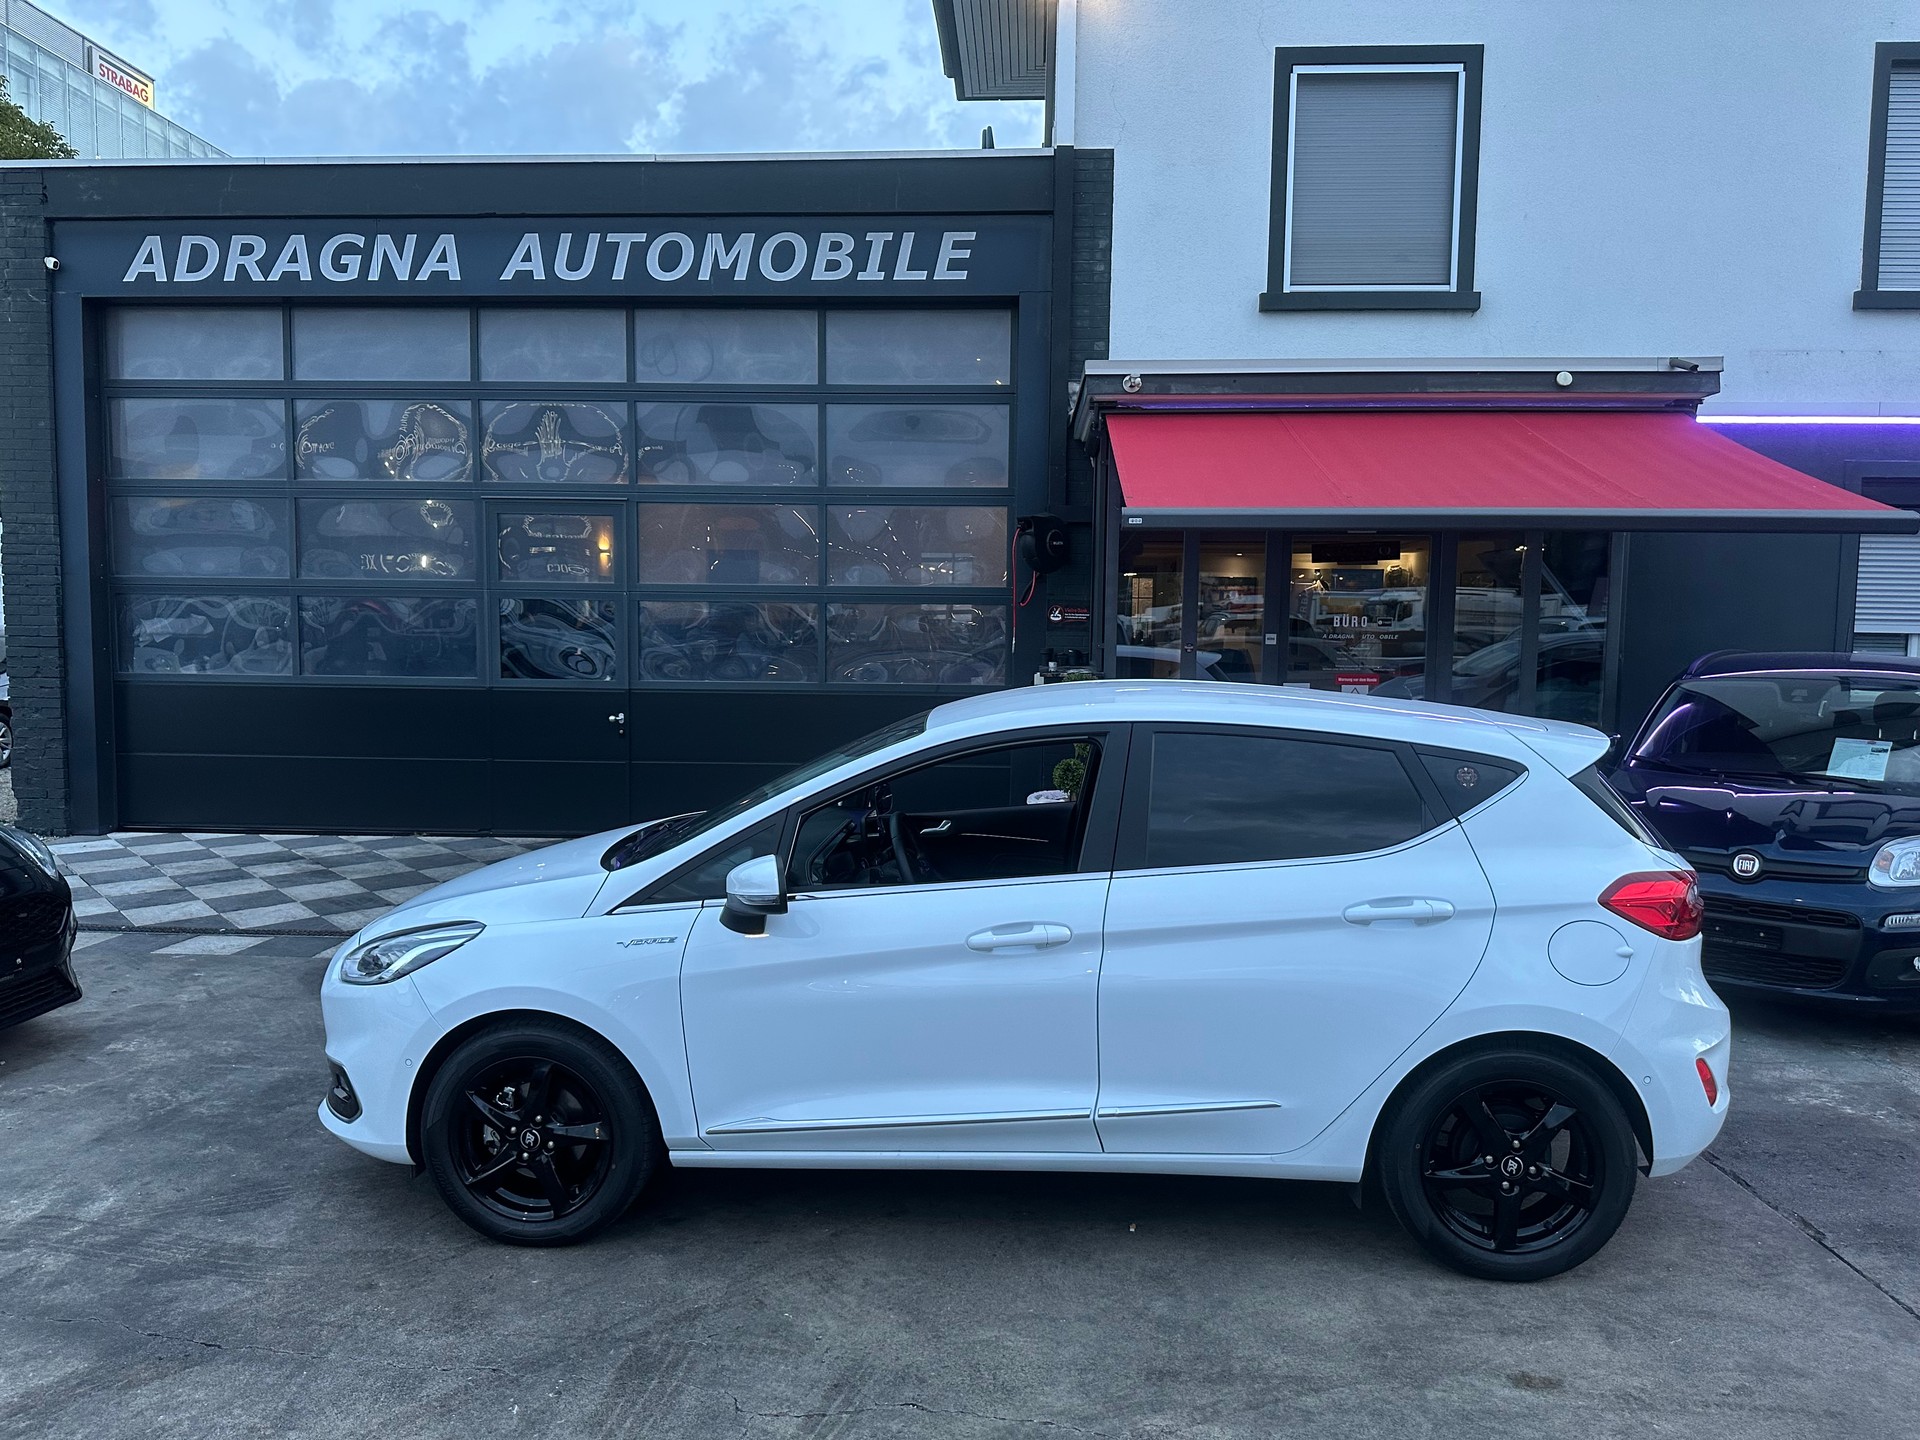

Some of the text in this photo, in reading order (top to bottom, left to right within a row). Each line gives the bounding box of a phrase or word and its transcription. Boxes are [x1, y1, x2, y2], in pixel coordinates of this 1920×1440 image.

[99, 63, 148, 102] STRABAG
[122, 231, 976, 282] ADRAGNA AUTOMOBILE
[1333, 614, 1368, 627] BÜRO
[1738, 859, 1754, 871] FIAT
